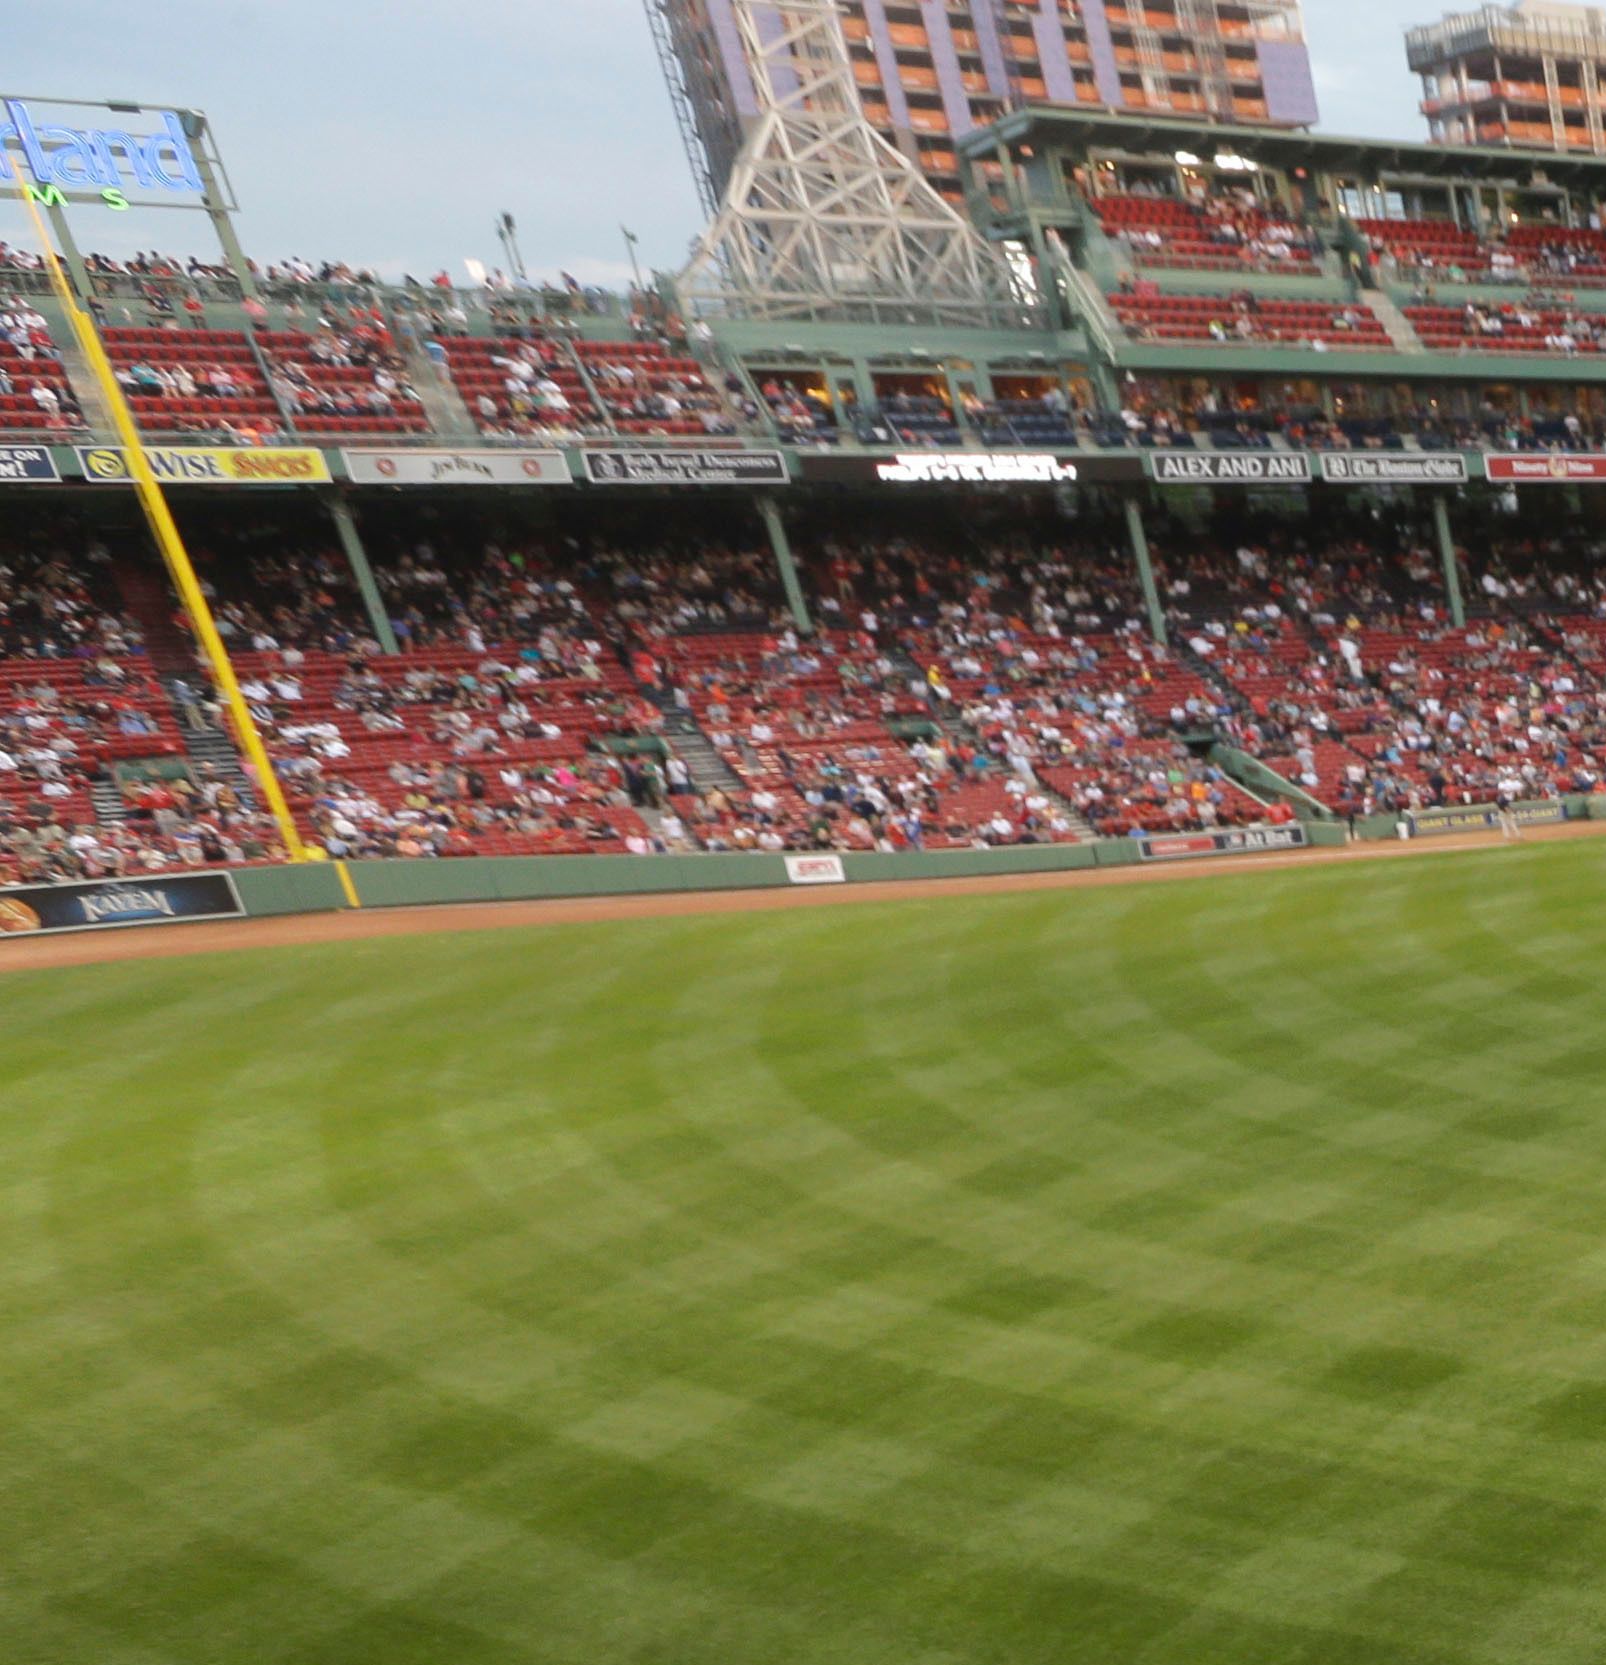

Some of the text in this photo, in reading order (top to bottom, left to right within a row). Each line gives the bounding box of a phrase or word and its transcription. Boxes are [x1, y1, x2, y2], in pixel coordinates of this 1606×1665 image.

[145, 449, 226, 478] WISE
[1164, 457, 1303, 477] ALEX AND ANI
[76, 888, 176, 923] KAYEM
